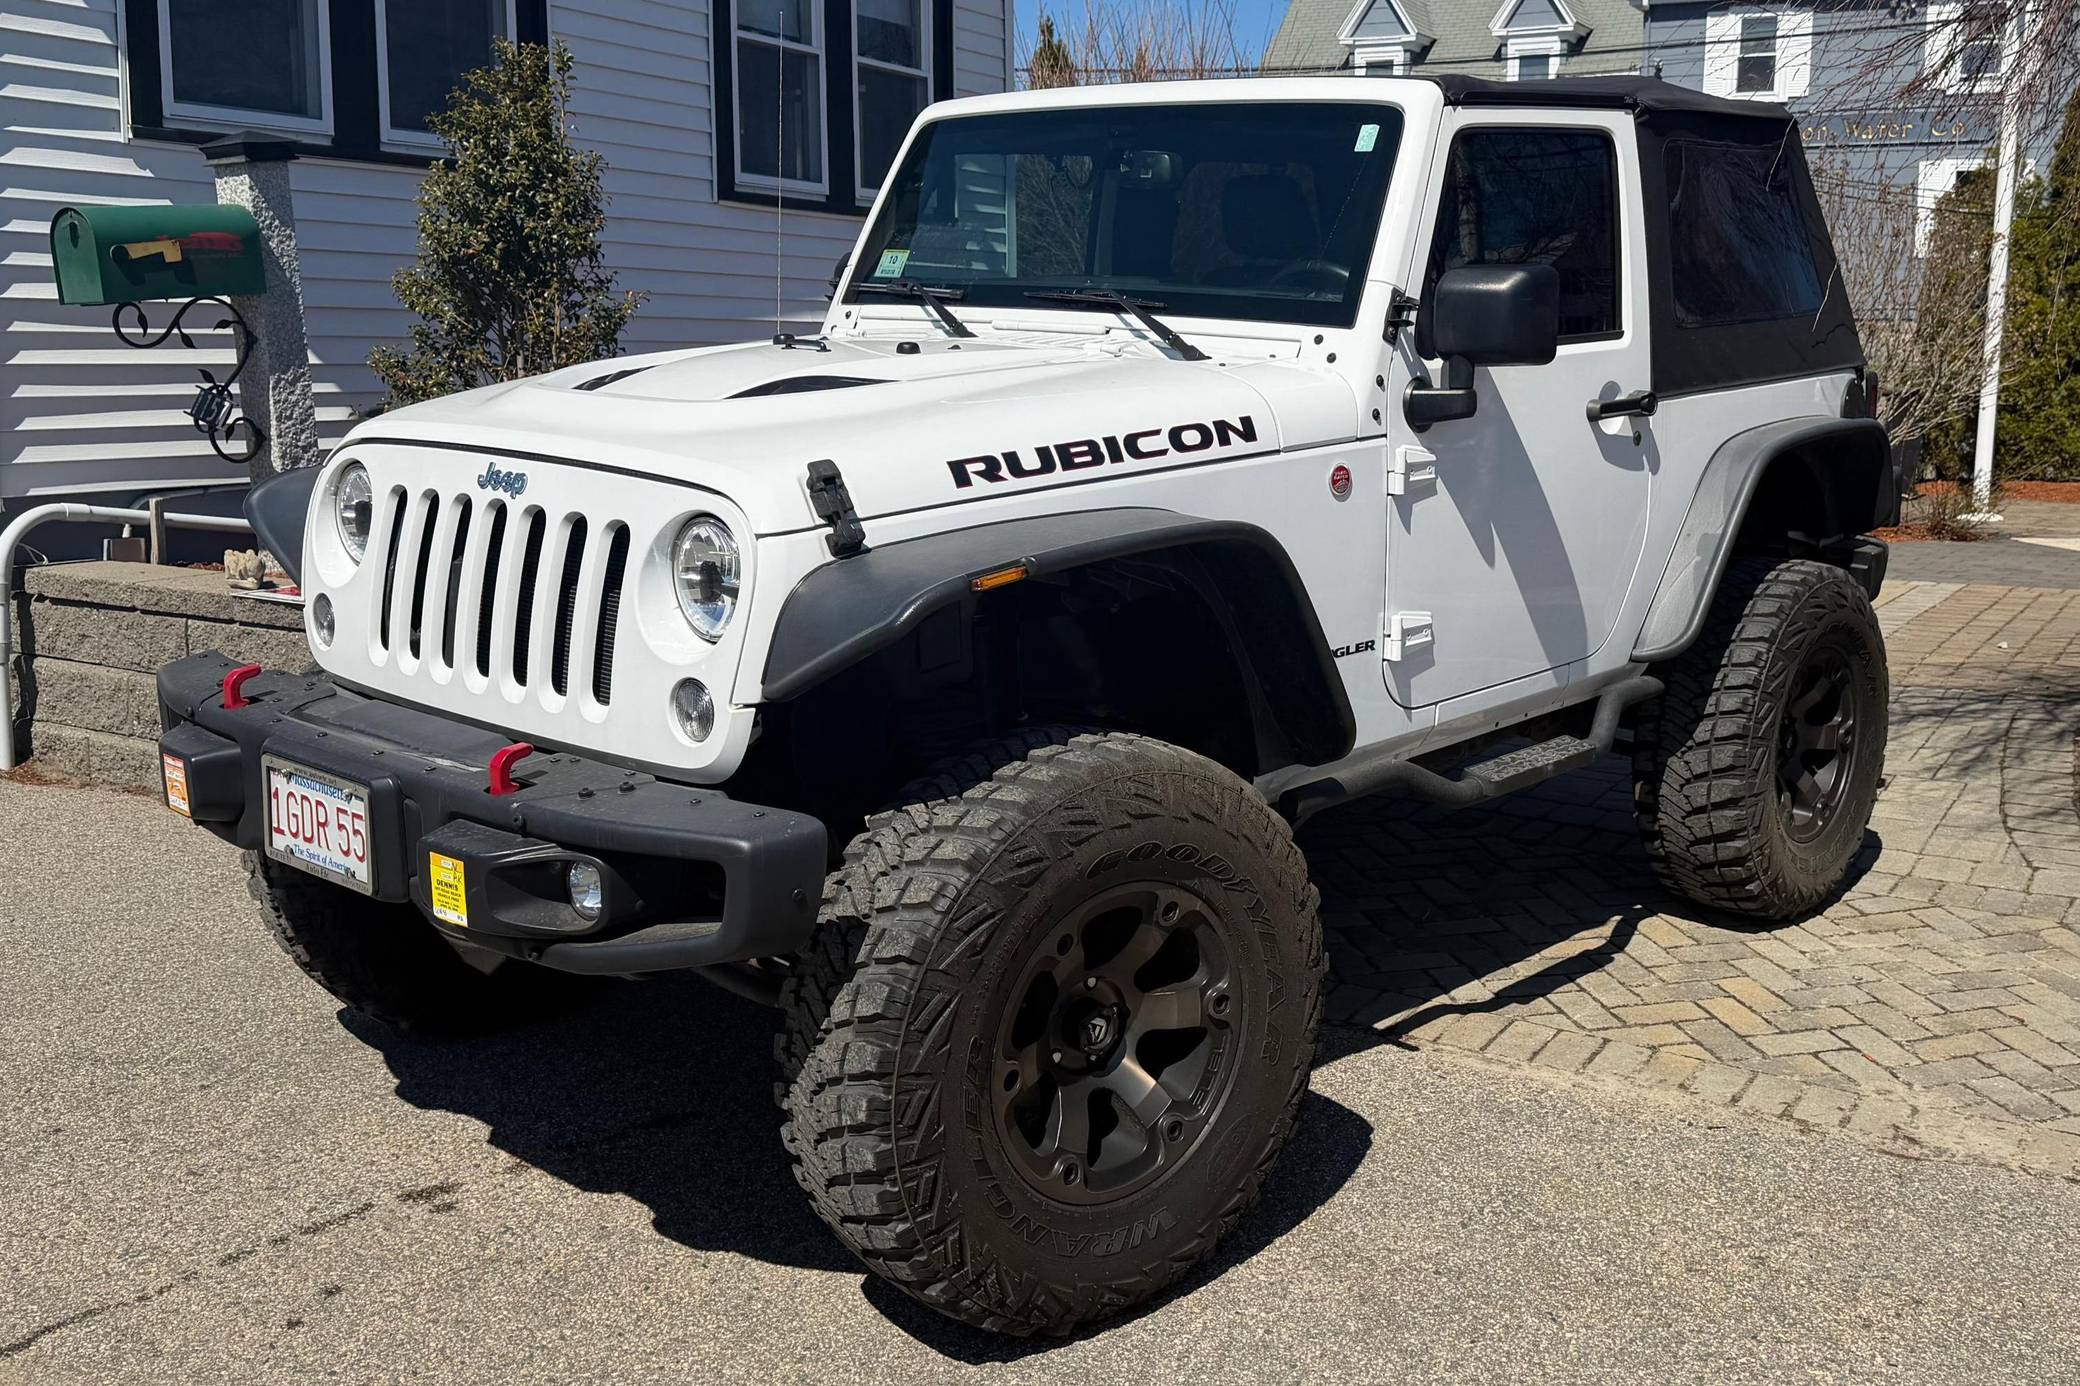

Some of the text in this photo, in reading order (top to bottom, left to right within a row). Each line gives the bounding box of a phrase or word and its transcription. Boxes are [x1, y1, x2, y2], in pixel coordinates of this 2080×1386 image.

[1844, 118, 1914, 139] Water
[1931, 115, 1966, 137] Co
[888, 255, 899, 265] 10
[947, 415, 1258, 489] RUBICON
[477, 462, 529, 500] Jeep
[1331, 639, 1376, 658] GLER
[272, 786, 366, 863] 1GDR 55
[293, 843, 304, 856] The
[305, 848, 321, 863] Spirit
[321, 854, 328, 866] of
[436, 879, 459, 891] DENNIS
[1085, 842, 1291, 1067] GOODYEAR
[960, 1034, 1180, 1260] WRANGLER
